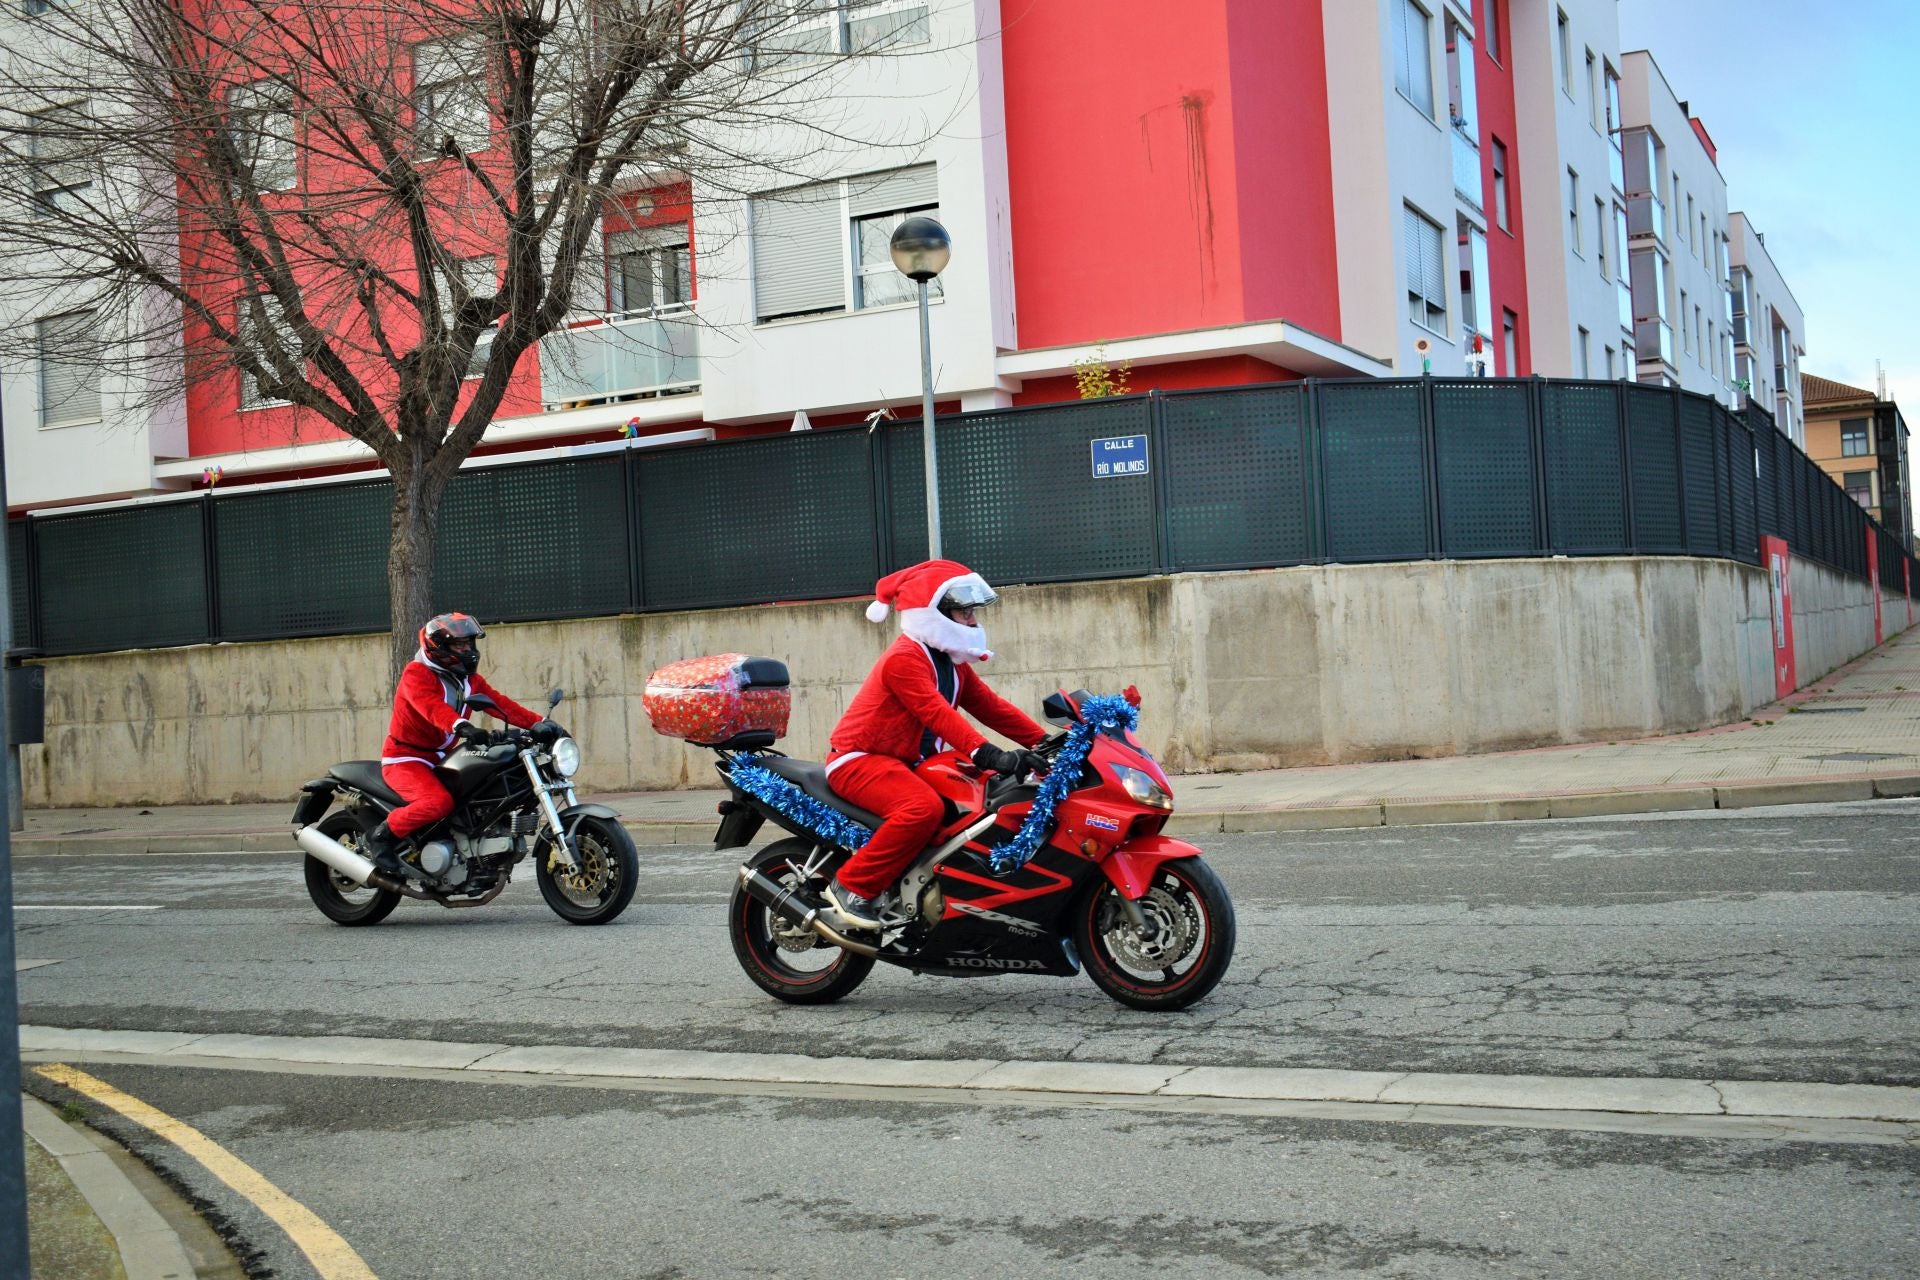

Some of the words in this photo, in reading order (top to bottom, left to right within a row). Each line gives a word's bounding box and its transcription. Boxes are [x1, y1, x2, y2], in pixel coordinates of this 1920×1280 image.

[1105, 440, 1134, 450] CALLE
[1097, 462, 1109, 474] RÍO
[1113, 460, 1144, 473] MOLINOS
[1008, 925, 1038, 938] moto
[944, 957, 1048, 969] HONDA
